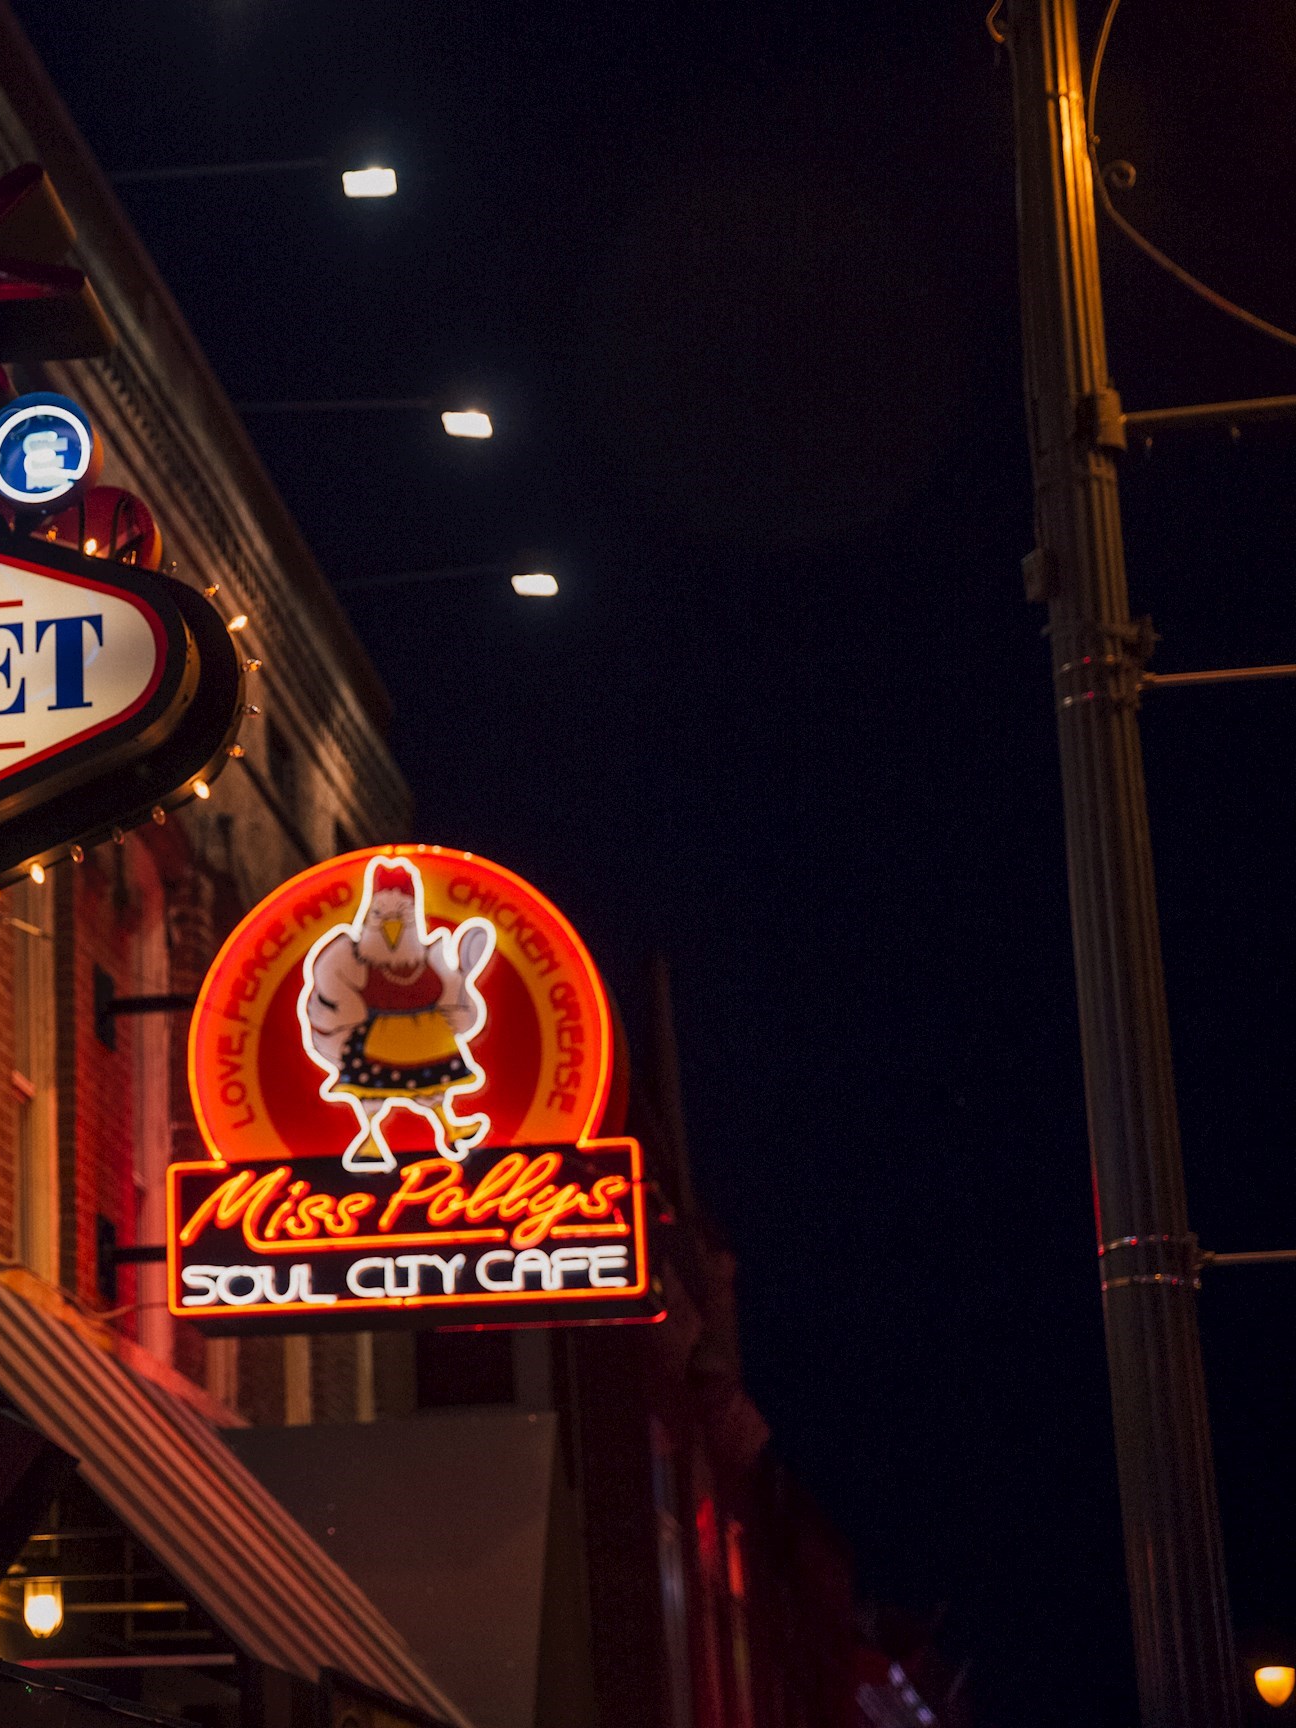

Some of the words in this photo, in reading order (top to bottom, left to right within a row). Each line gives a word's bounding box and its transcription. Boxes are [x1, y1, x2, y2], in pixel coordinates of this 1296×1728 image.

[222, 920, 295, 1022] PEACE
[291, 879, 354, 930] AND
[447, 875, 561, 978] CHICKEN
[545, 980, 587, 1115] GREASE
[178, 1164, 377, 1253] Miss
[180, 1262, 338, 1307] SOUL
[345, 1252, 468, 1299] CITY
[475, 1244, 630, 1293] CAFE
